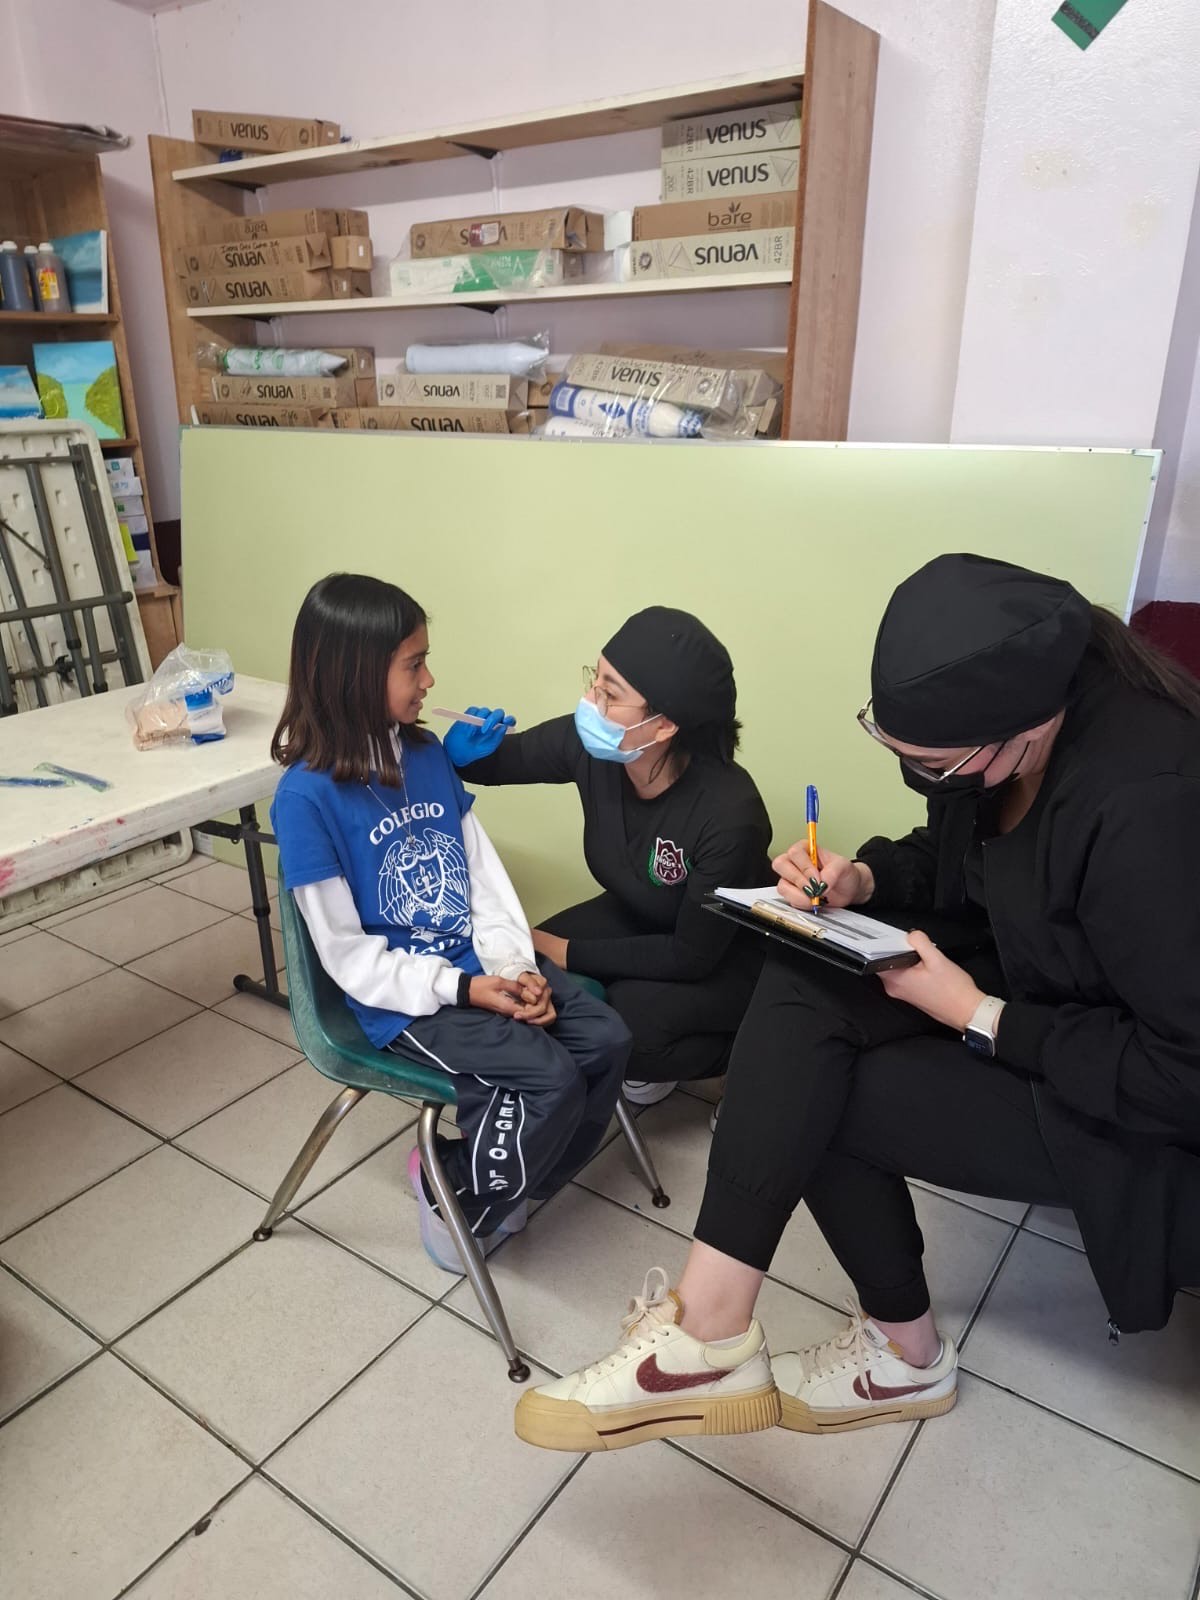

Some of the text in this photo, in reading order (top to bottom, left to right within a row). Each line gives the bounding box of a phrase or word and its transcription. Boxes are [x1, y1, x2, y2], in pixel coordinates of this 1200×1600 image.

[230, 122, 269, 141] venus
[706, 118, 767, 144] venus
[707, 163, 769, 187] venus
[708, 211, 752, 227] bare
[225, 250, 266, 268] venus
[695, 243, 759, 265] venus
[774, 235, 783, 264] 42BR
[225, 280, 272, 299] venus
[610, 365, 663, 388] venus
[257, 384, 294, 399] venus
[423, 384, 461, 397] venus
[410, 417, 465, 433] venus
[369, 802, 445, 846] COLEGIO
[489, 1088, 515, 1160] LEGIO
